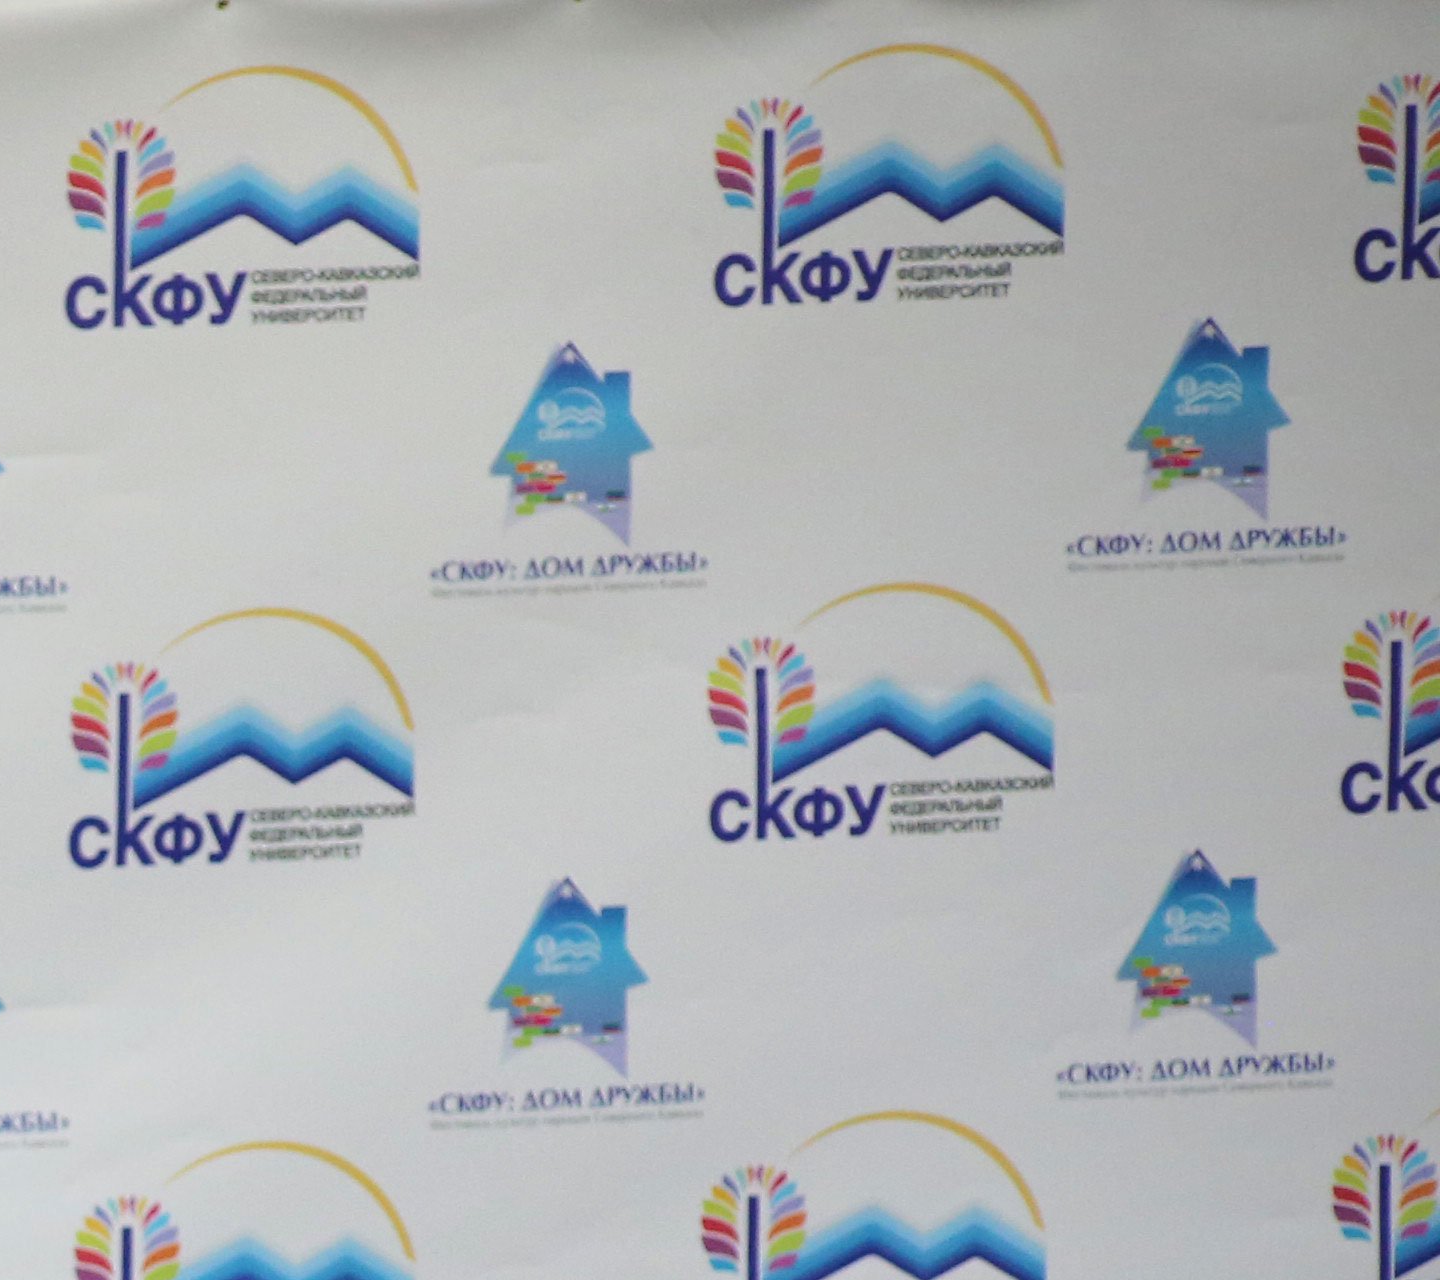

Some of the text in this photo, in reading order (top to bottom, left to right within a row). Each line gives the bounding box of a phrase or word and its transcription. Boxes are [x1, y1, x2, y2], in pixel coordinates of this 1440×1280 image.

[713, 250, 894, 307] СКФУ
[1353, 227, 1440, 283] СК
[66, 275, 245, 330] СКФУ
[522, 555, 585, 582] ДОМ
[1159, 529, 1223, 556] ДОМ
[68, 811, 245, 871] СКФУ
[711, 785, 885, 843] СКФУ
[1151, 1056, 1211, 1083] ДОМ
[522, 1086, 582, 1112] ДОМ
